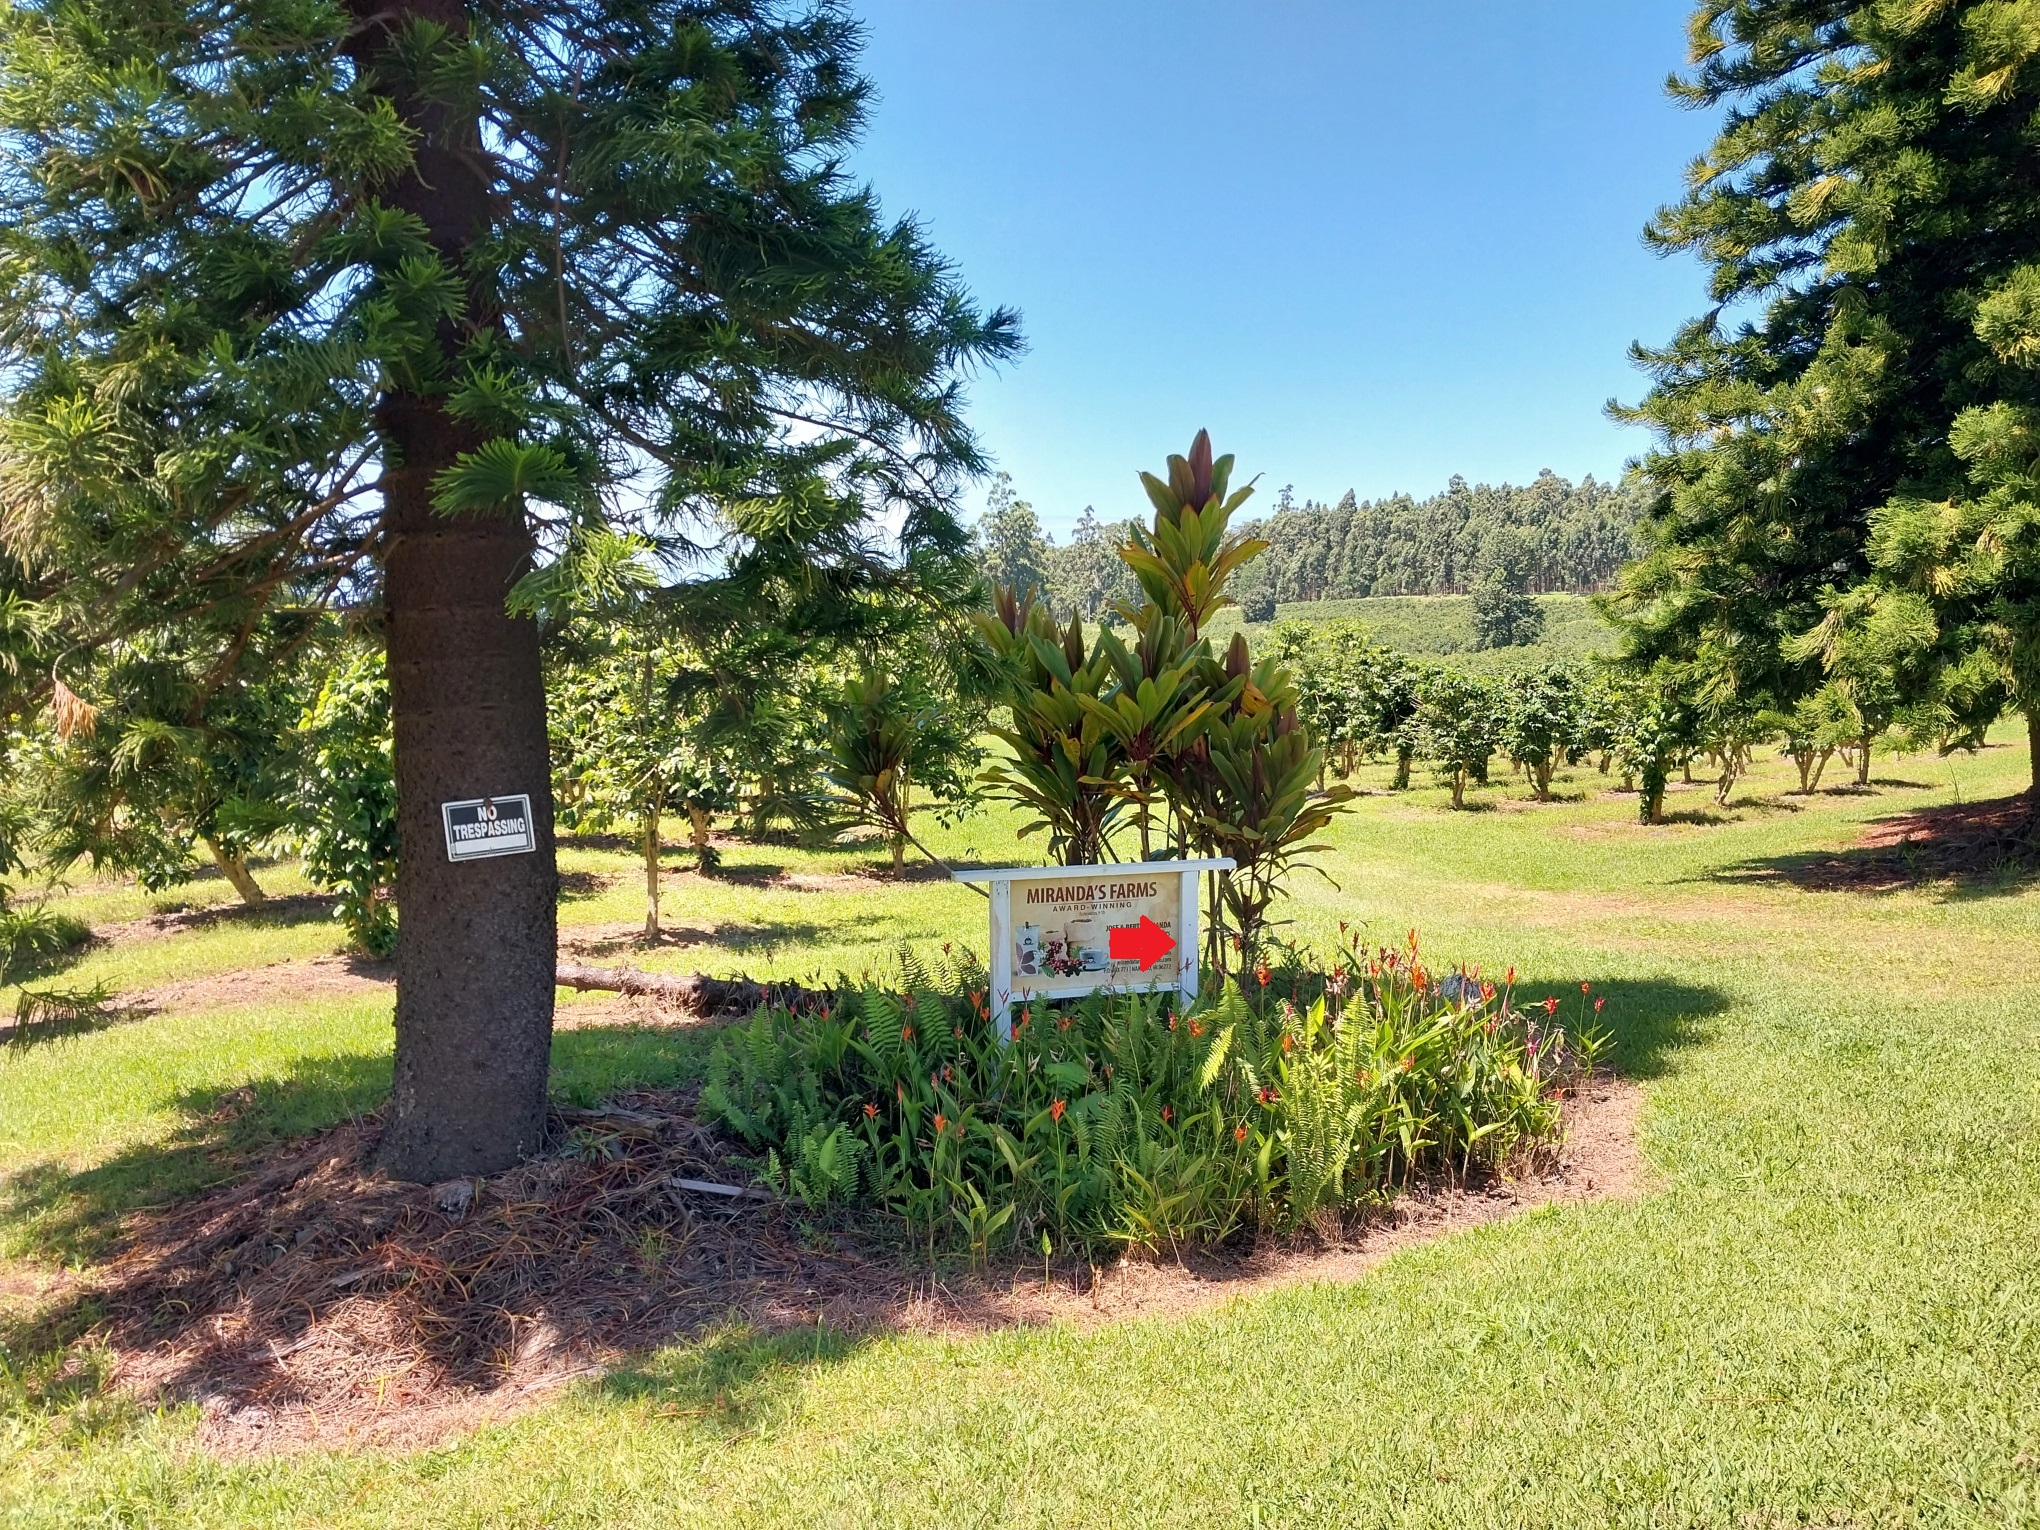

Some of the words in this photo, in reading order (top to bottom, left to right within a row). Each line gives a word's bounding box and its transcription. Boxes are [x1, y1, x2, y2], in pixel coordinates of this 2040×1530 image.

[477, 806, 498, 821] NO
[453, 817, 526, 840] TRESPASSING
[1026, 884, 1107, 904] MIRANDA'S
[1110, 881, 1158, 899] FARMS
[1052, 901, 1133, 912] AWARD-WINNING
